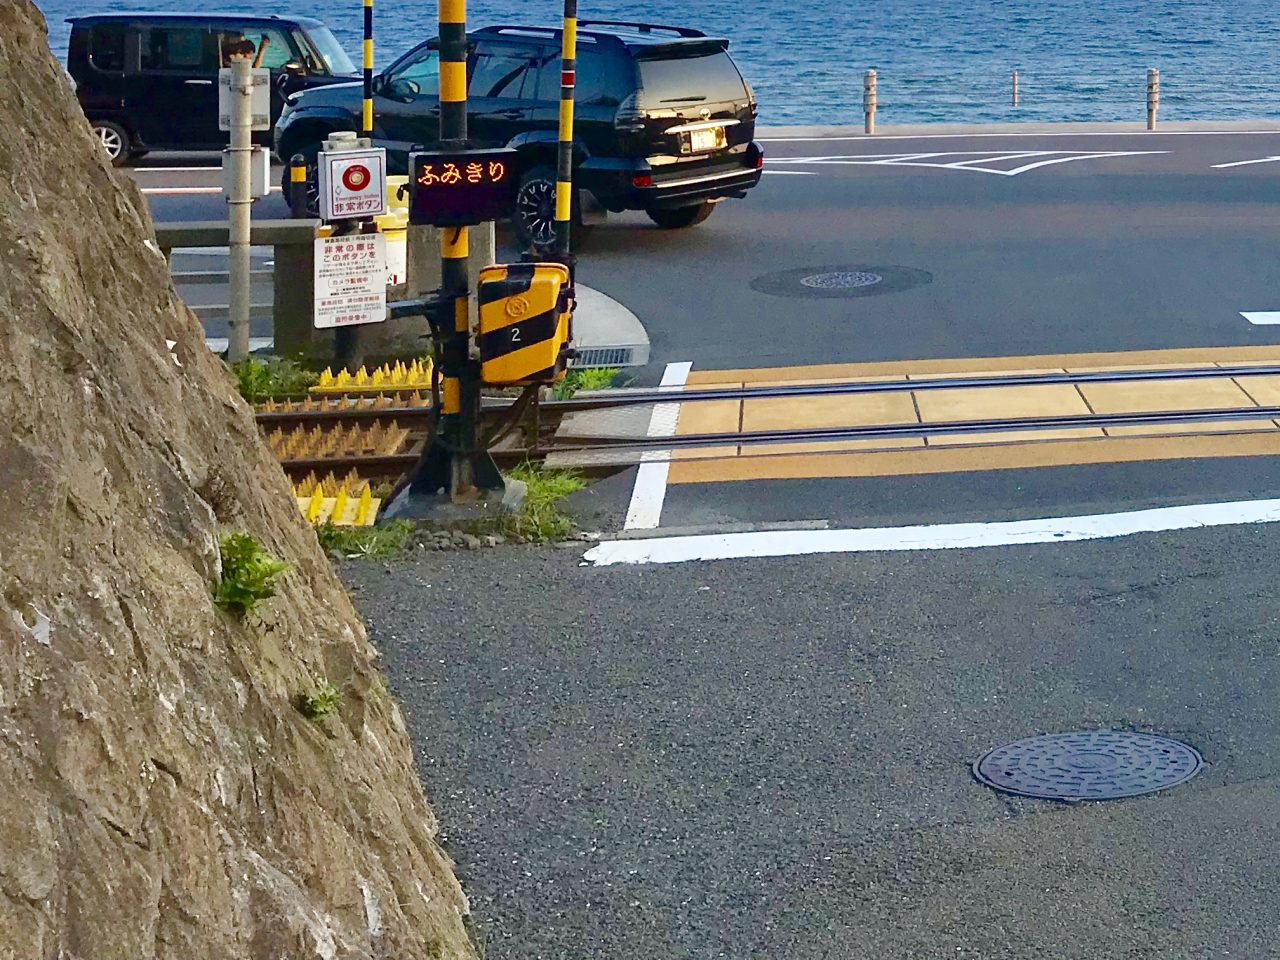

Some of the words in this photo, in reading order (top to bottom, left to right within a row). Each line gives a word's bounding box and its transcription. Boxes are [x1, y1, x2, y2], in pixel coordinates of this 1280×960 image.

[418, 161, 504, 185] ふみきり
[334, 200, 380, 213] 非常ボタン
[324, 243, 375, 254] 非常の際は
[323, 251, 376, 262] このボタンを
[511, 327, 521, 342] 2
